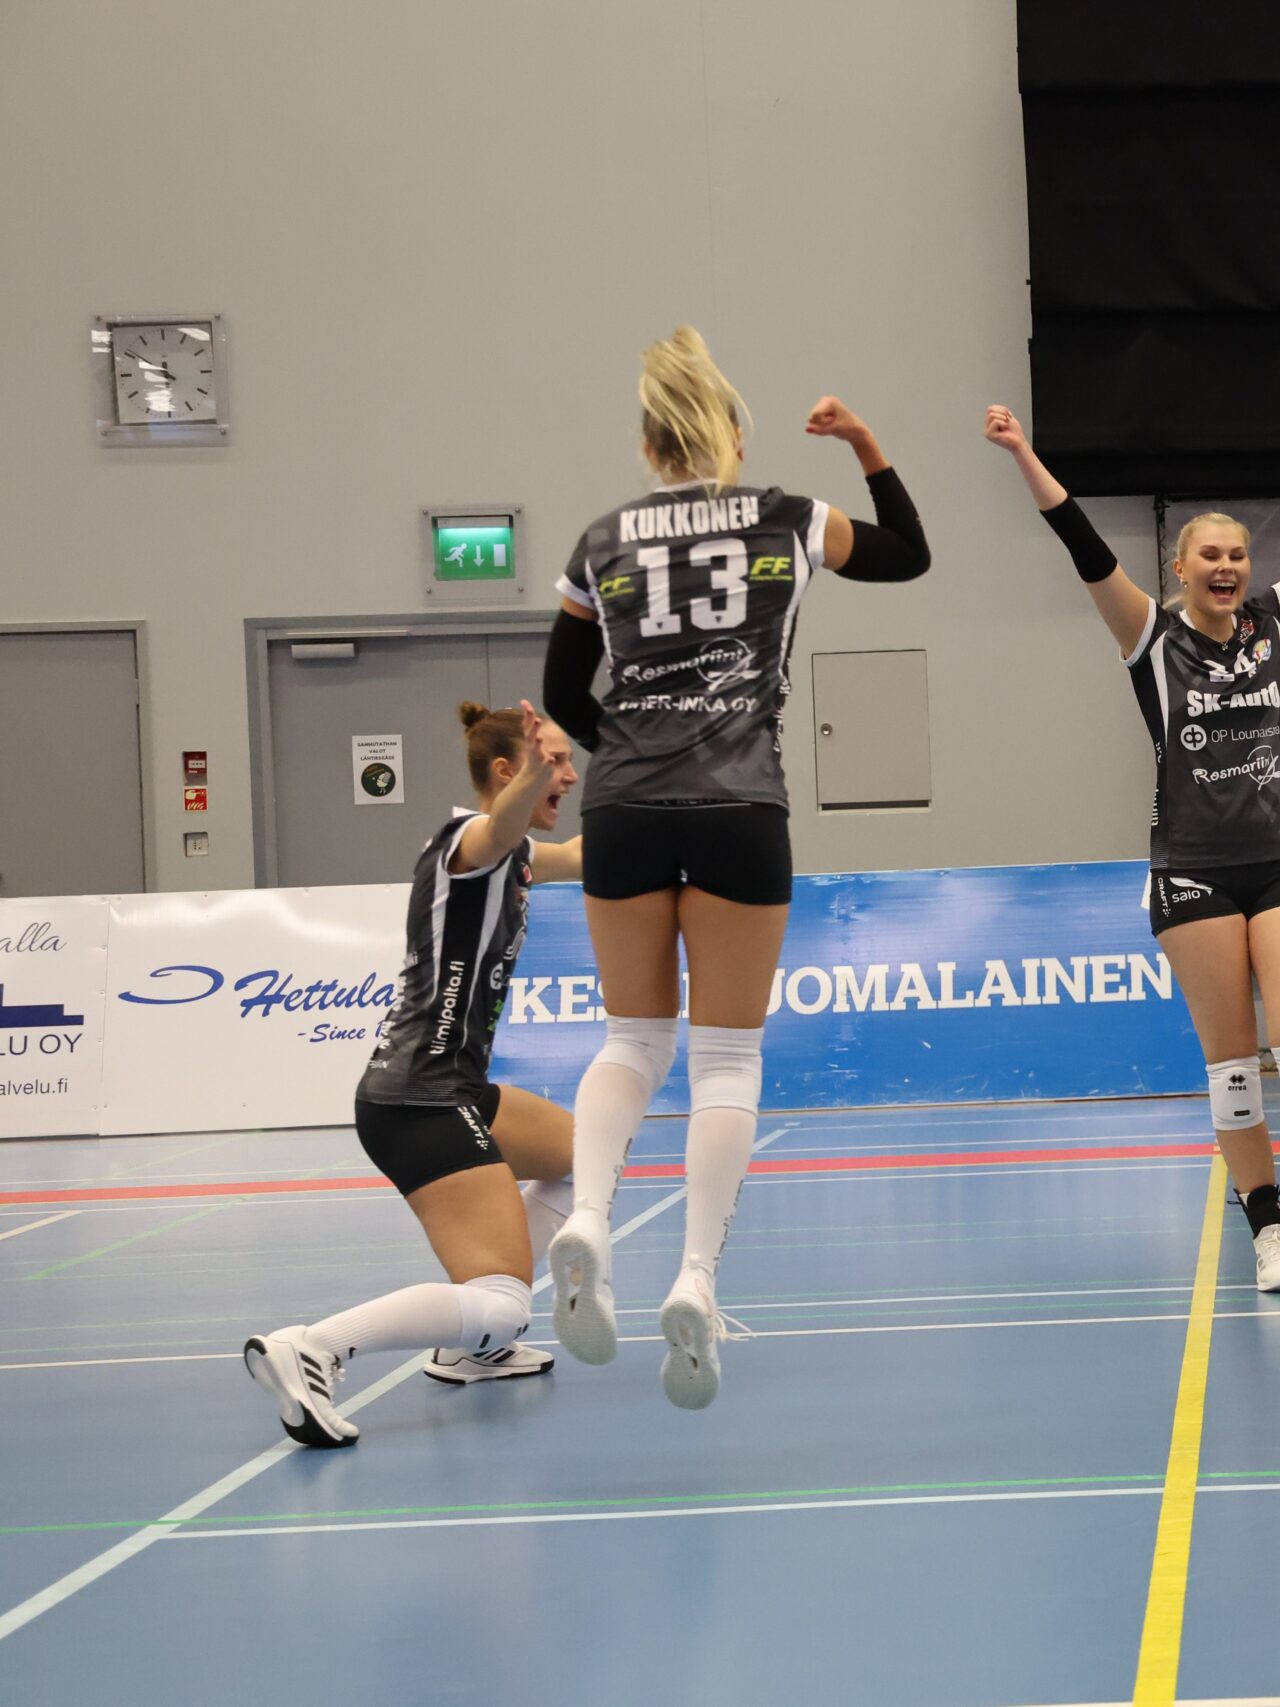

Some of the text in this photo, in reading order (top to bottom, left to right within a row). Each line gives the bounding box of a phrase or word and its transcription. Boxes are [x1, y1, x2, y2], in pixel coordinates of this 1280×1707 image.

[620, 496, 759, 543] KUKKONEN
[637, 538, 748, 637] 13
[1211, 729, 1228, 743] OP
[1171, 888, 1201, 903] salo
[39, 1033, 82, 1055] OY
